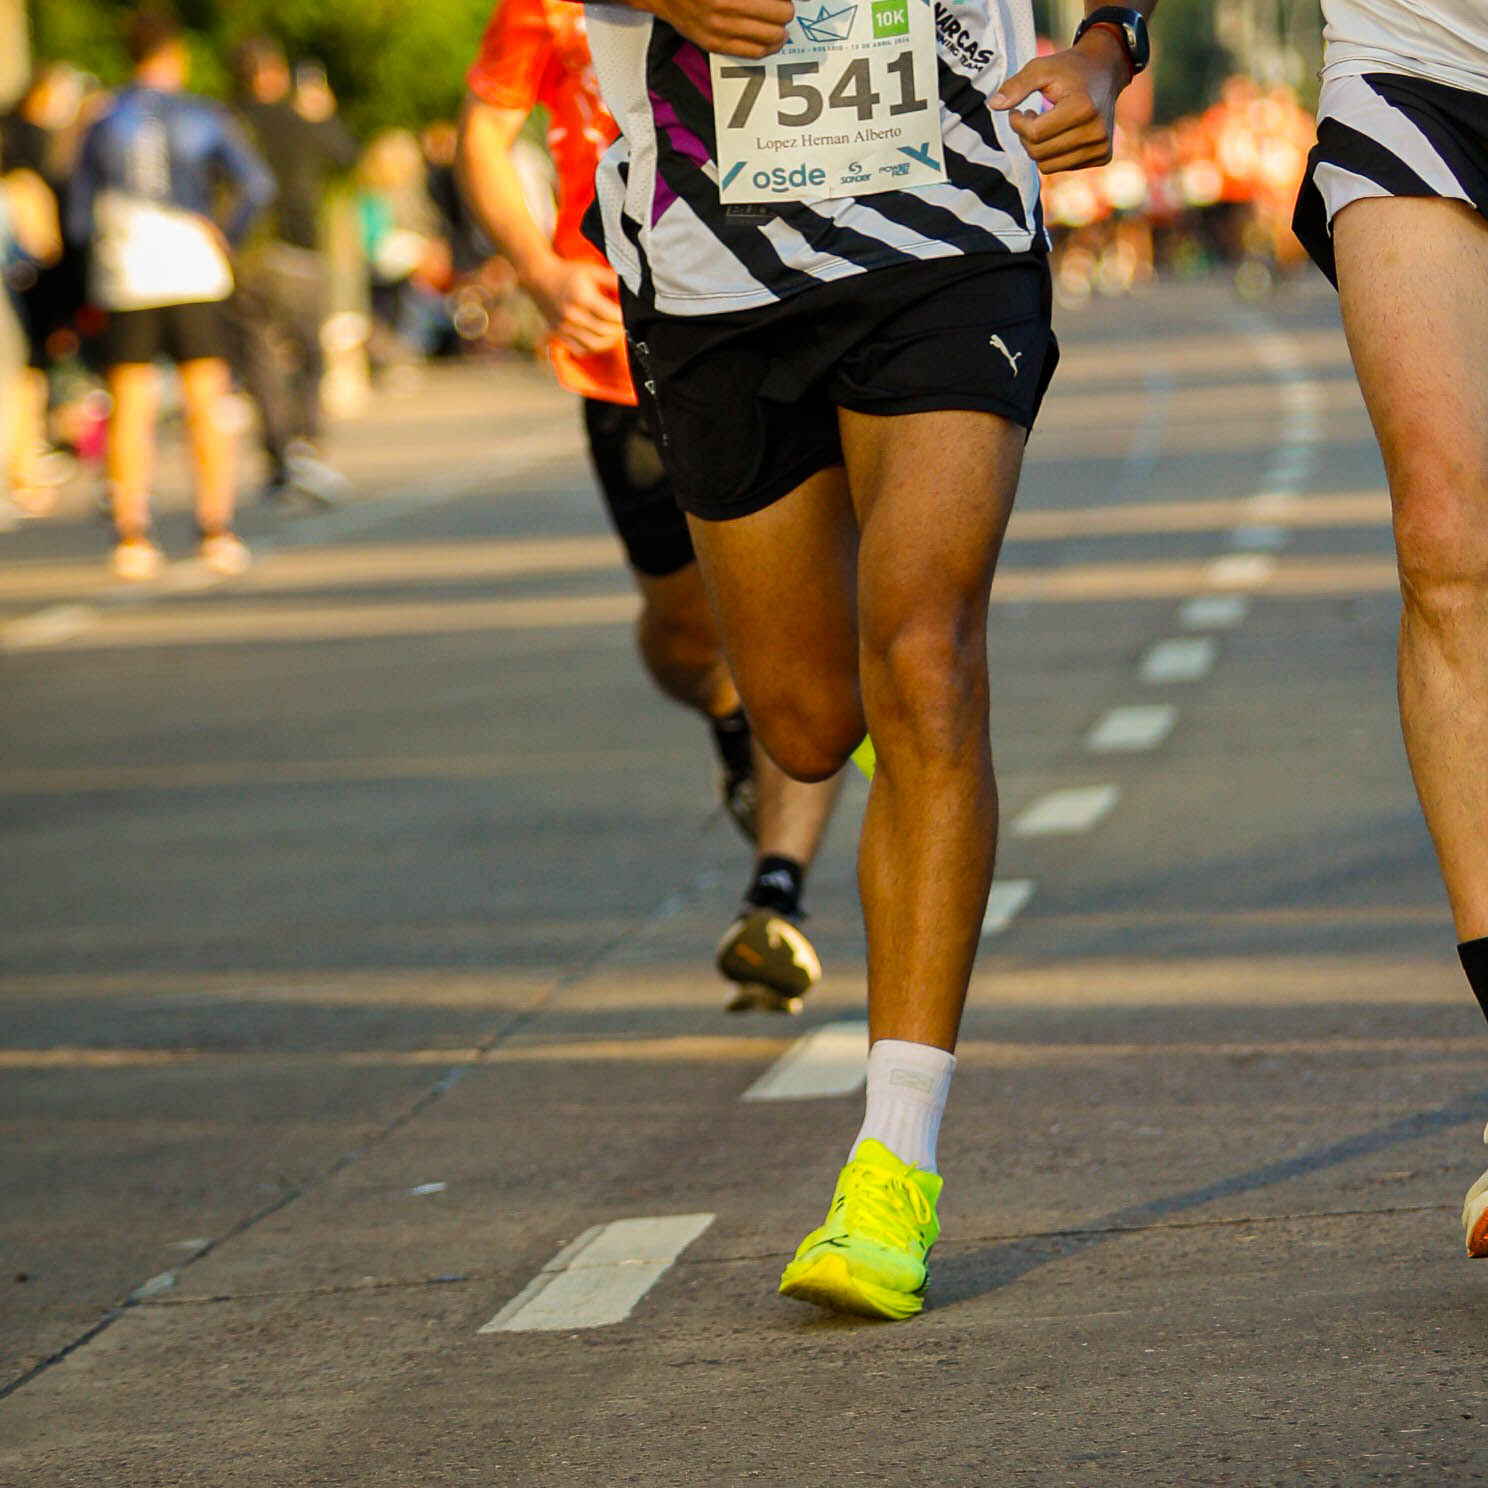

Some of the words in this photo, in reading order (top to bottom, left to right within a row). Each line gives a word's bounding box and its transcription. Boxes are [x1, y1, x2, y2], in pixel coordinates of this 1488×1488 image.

[876, 8, 905, 28] 10K
[720, 50, 928, 129] 7541
[756, 136, 797, 152] Lopez
[801, 133, 850, 147] Hernan
[854, 127, 902, 144] Alberto
[752, 162, 826, 193] osde
